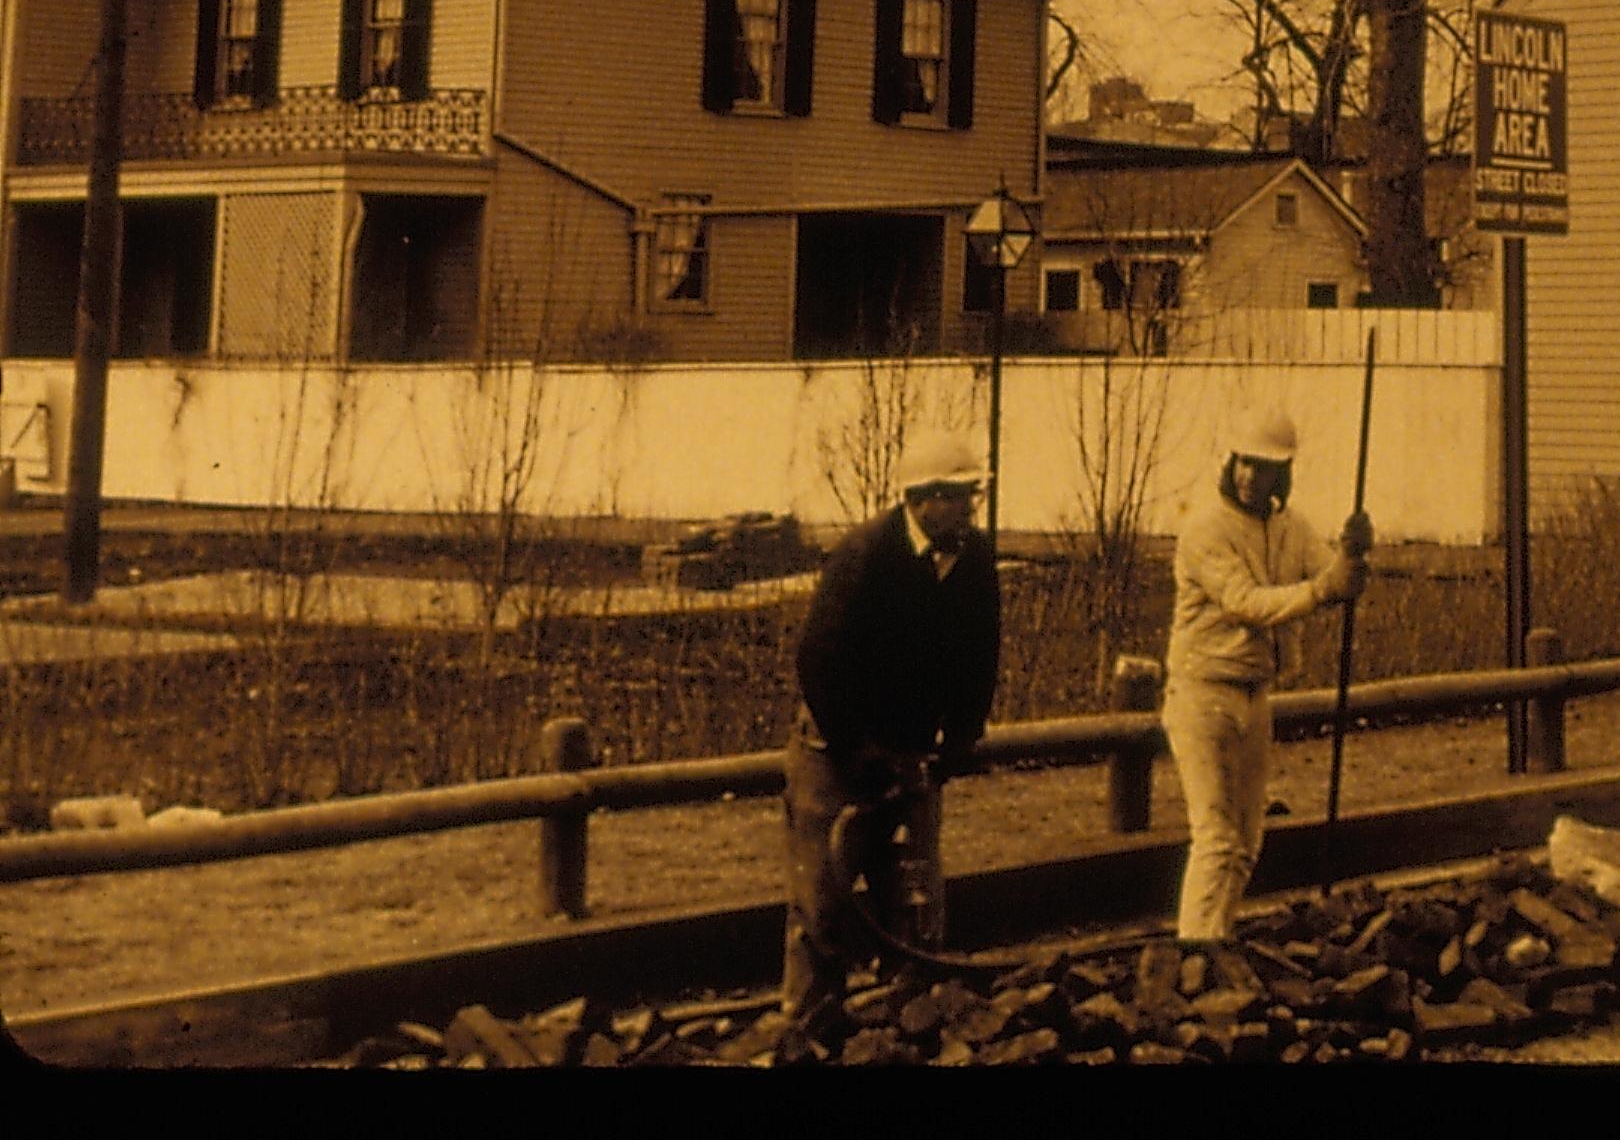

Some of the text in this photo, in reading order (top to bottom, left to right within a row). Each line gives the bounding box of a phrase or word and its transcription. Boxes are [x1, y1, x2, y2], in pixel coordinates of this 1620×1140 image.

[1480, 19, 1564, 71] LINCOLN
[1493, 66, 1551, 115] HOME
[1492, 112, 1550, 159] AREA
[1477, 167, 1567, 196] STREET CLOSED
